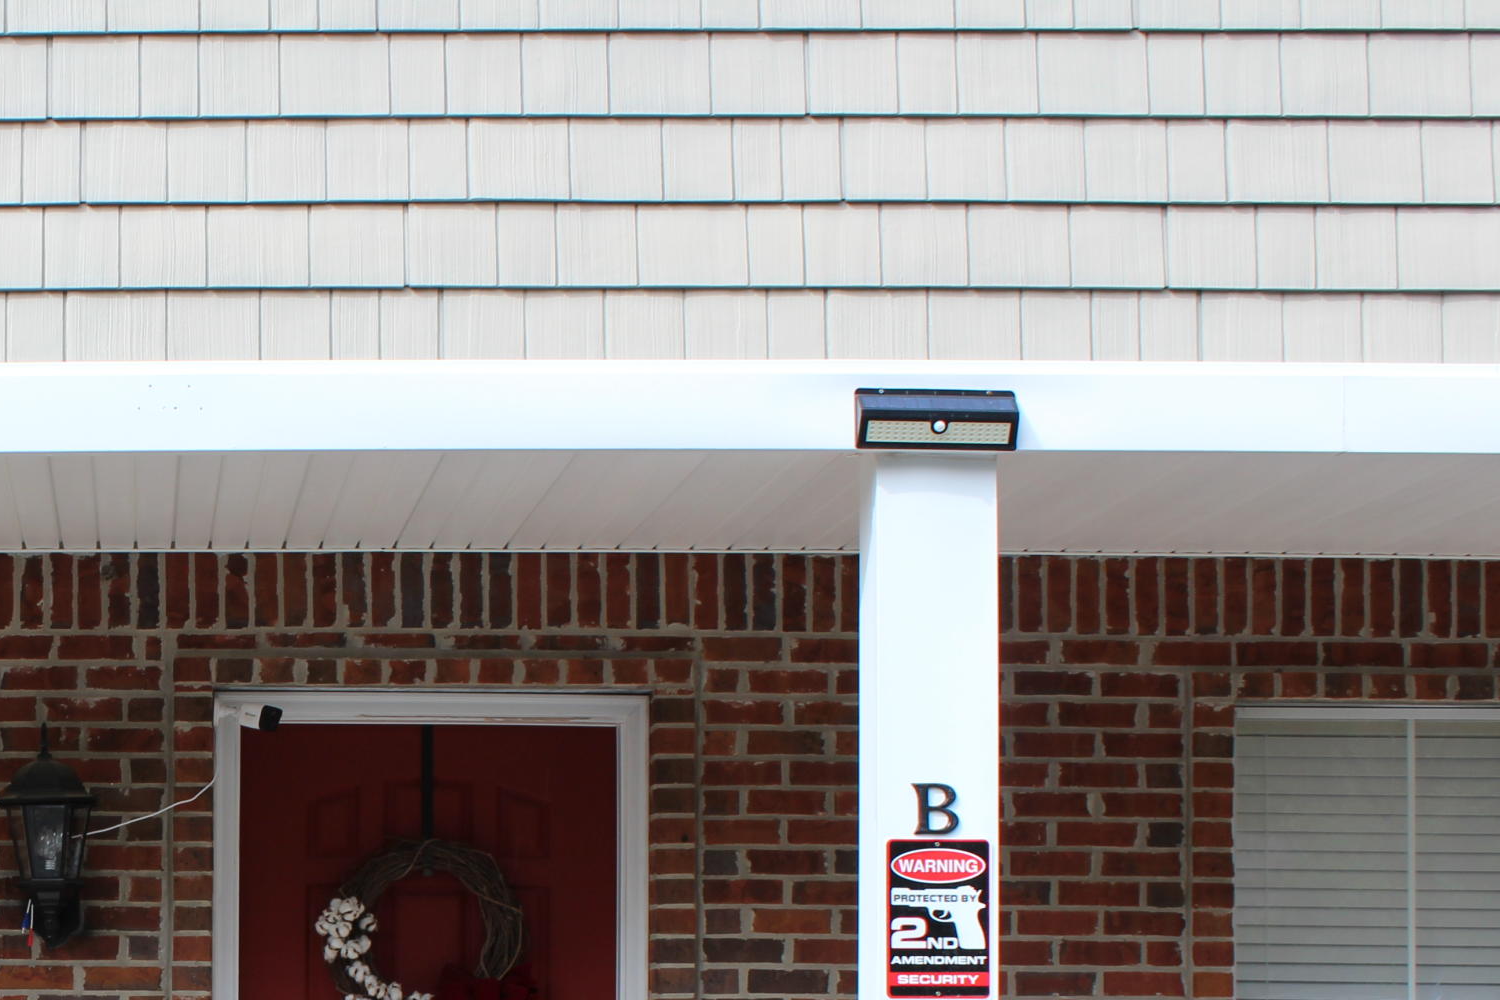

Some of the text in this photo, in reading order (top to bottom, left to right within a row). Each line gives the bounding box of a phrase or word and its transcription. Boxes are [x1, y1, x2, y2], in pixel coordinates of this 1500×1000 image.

[911, 783, 960, 836] B
[899, 859, 978, 873] WARNING
[893, 894, 977, 903] PROTECTED BY
[890, 916, 958, 950] 2ND
[891, 955, 988, 966] AMENDMENT
[897, 974, 980, 985] SECURITY
